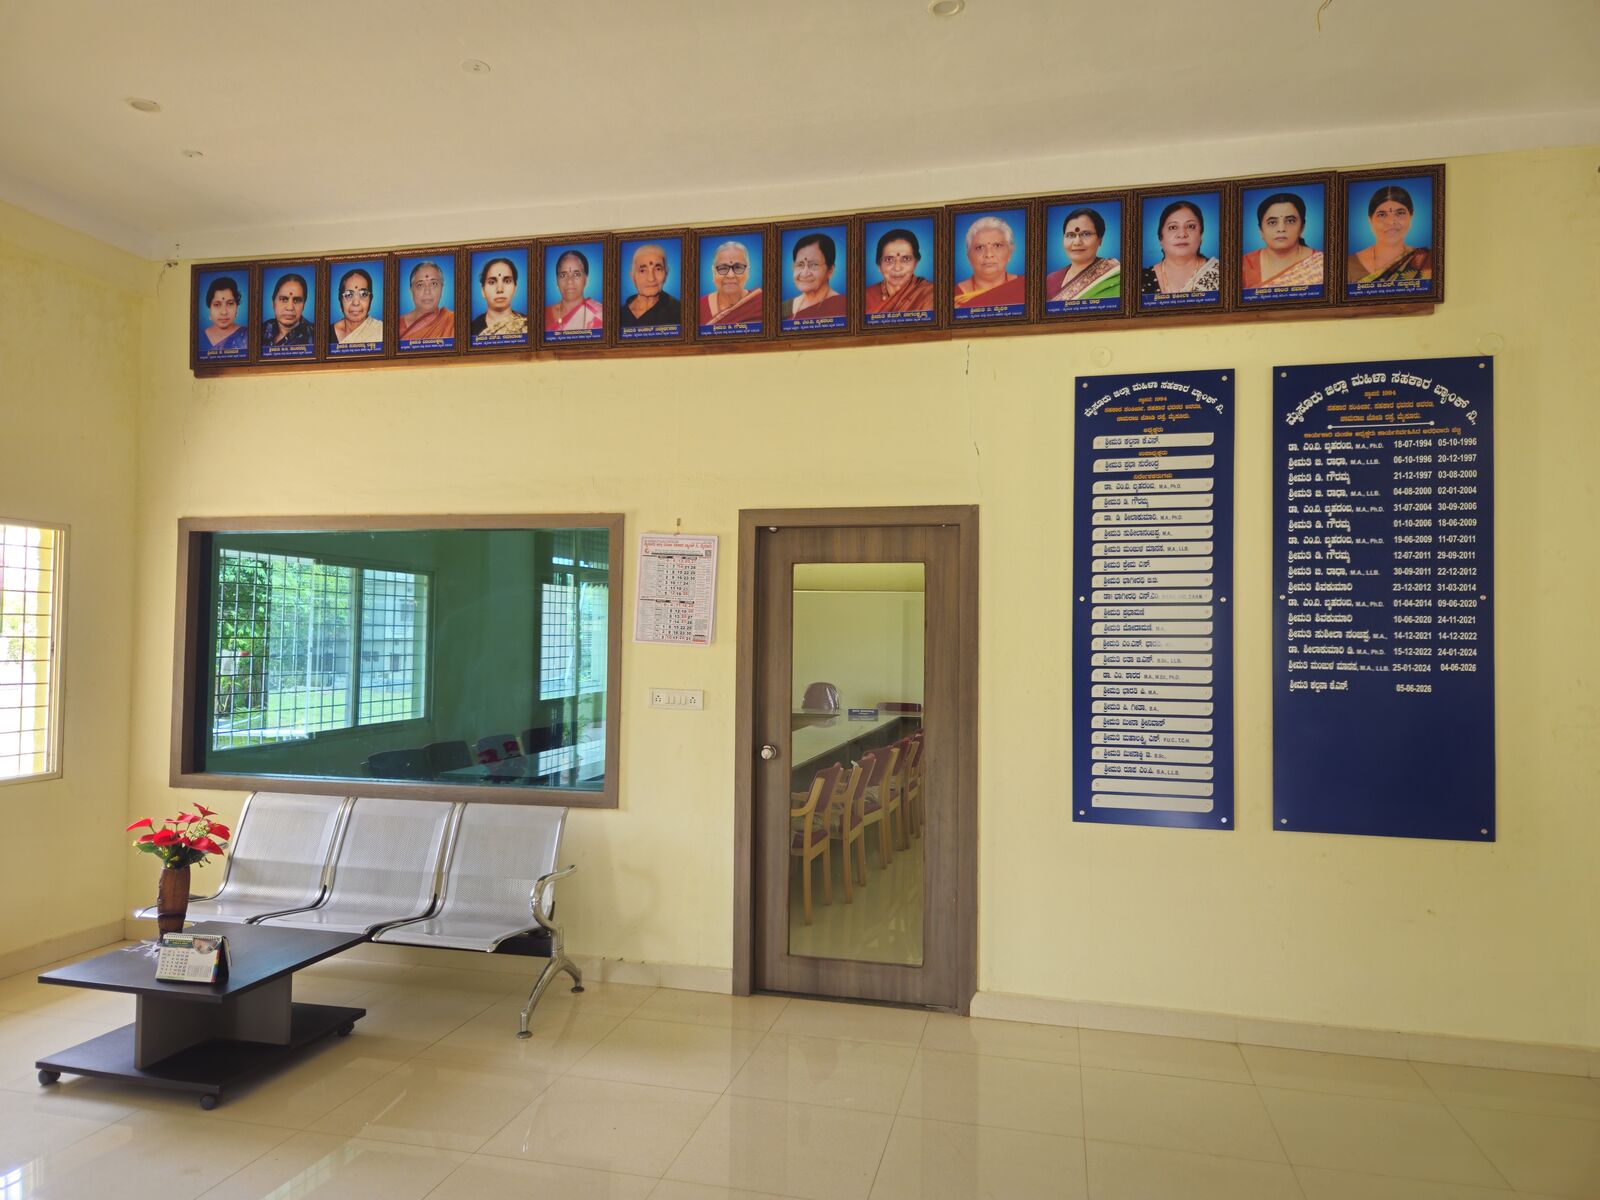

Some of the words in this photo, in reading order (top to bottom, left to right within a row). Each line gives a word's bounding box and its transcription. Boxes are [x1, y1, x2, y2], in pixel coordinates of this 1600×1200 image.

[1084, 395, 1112, 417] ಮೈಸೂರು
[1132, 382, 1158, 391] ಮಹಿಳಾ
[1161, 382, 1190, 392] ಸಹಕಾರ
[1286, 392, 1323, 425] ಮೈಸೂರು
[1351, 373, 1386, 386] ಮಹಿಳಾ
[1392, 372, 1432, 389] ಸಹಕಾರ
[1434, 385, 1470, 408] ಬ್ಯಾಂಕ್
[1105, 439, 1122, 448] ಶ್ರೀಮತಿ
[1394, 439, 1432, 448] 18-07-1994
[1438, 438, 1477, 447] 05-10-1996
[1105, 462, 1122, 471] ಶ್ರೀಮತಿ
[1288, 458, 1312, 470] ಶ್ರೀಮತಿ
[1438, 454, 1477, 463] 20-12-1997
[1288, 473, 1312, 486] ಶ್ರೀಮತಿ
[1394, 471, 1432, 480] 21-12-1997
[1438, 470, 1477, 479] 03-08-2000
[1288, 489, 1312, 501] ಶ್ರೀಮತಿ
[1438, 486, 1477, 495] 02-01-2004
[1104, 498, 1121, 508] ಶ್ರೀಮತಿ
[1394, 503, 1432, 511] 31-07-2004
[1438, 502, 1477, 511] 30-09-2006
[1288, 520, 1312, 532] ಶ್ರೀಮತಿ
[1393, 519, 1432, 527] 01-10-2006
[1438, 519, 1477, 527] 18-06-2009
[1438, 535, 1476, 543] 11-07-2011
[1288, 551, 1312, 563] ಶ್ರೀಮತಿ
[1394, 551, 1431, 559] 12-07-2011
[1437, 551, 1475, 559] 29-09-2011
[1288, 566, 1312, 579] ಶ್ರೀಮತಿ
[1437, 568, 1477, 576] 22-12-2012
[1288, 582, 1312, 594] ಶ್ರೀಮತಿ
[1393, 583, 1431, 591] 23-12-2012
[1394, 599, 1432, 607] 01-04-2014
[1438, 599, 1477, 607] 09-06-2020
[1288, 613, 1312, 625] ಶ್ರೀಮತಿ
[1438, 616, 1476, 624] 24-11-2021
[1288, 629, 1312, 641] ಶ್ರೀಮತಿ
[1394, 632, 1432, 640] 14-12-2021
[1438, 632, 1477, 640] 14-12-2022
[1394, 648, 1432, 656] 15-12-2022
[1438, 648, 1477, 656] 24-01-2024
[1288, 660, 1309, 672] ಶ್ರೀಮತಿ
[1392, 664, 1431, 672] 25-01-2024
[1289, 680, 1309, 692] ಶ್ರೀಮತಿ
[1104, 703, 1120, 713] ಶ್ರೀಮತಿ
[1103, 718, 1120, 728] ಶ್ರೀಮತಿ
